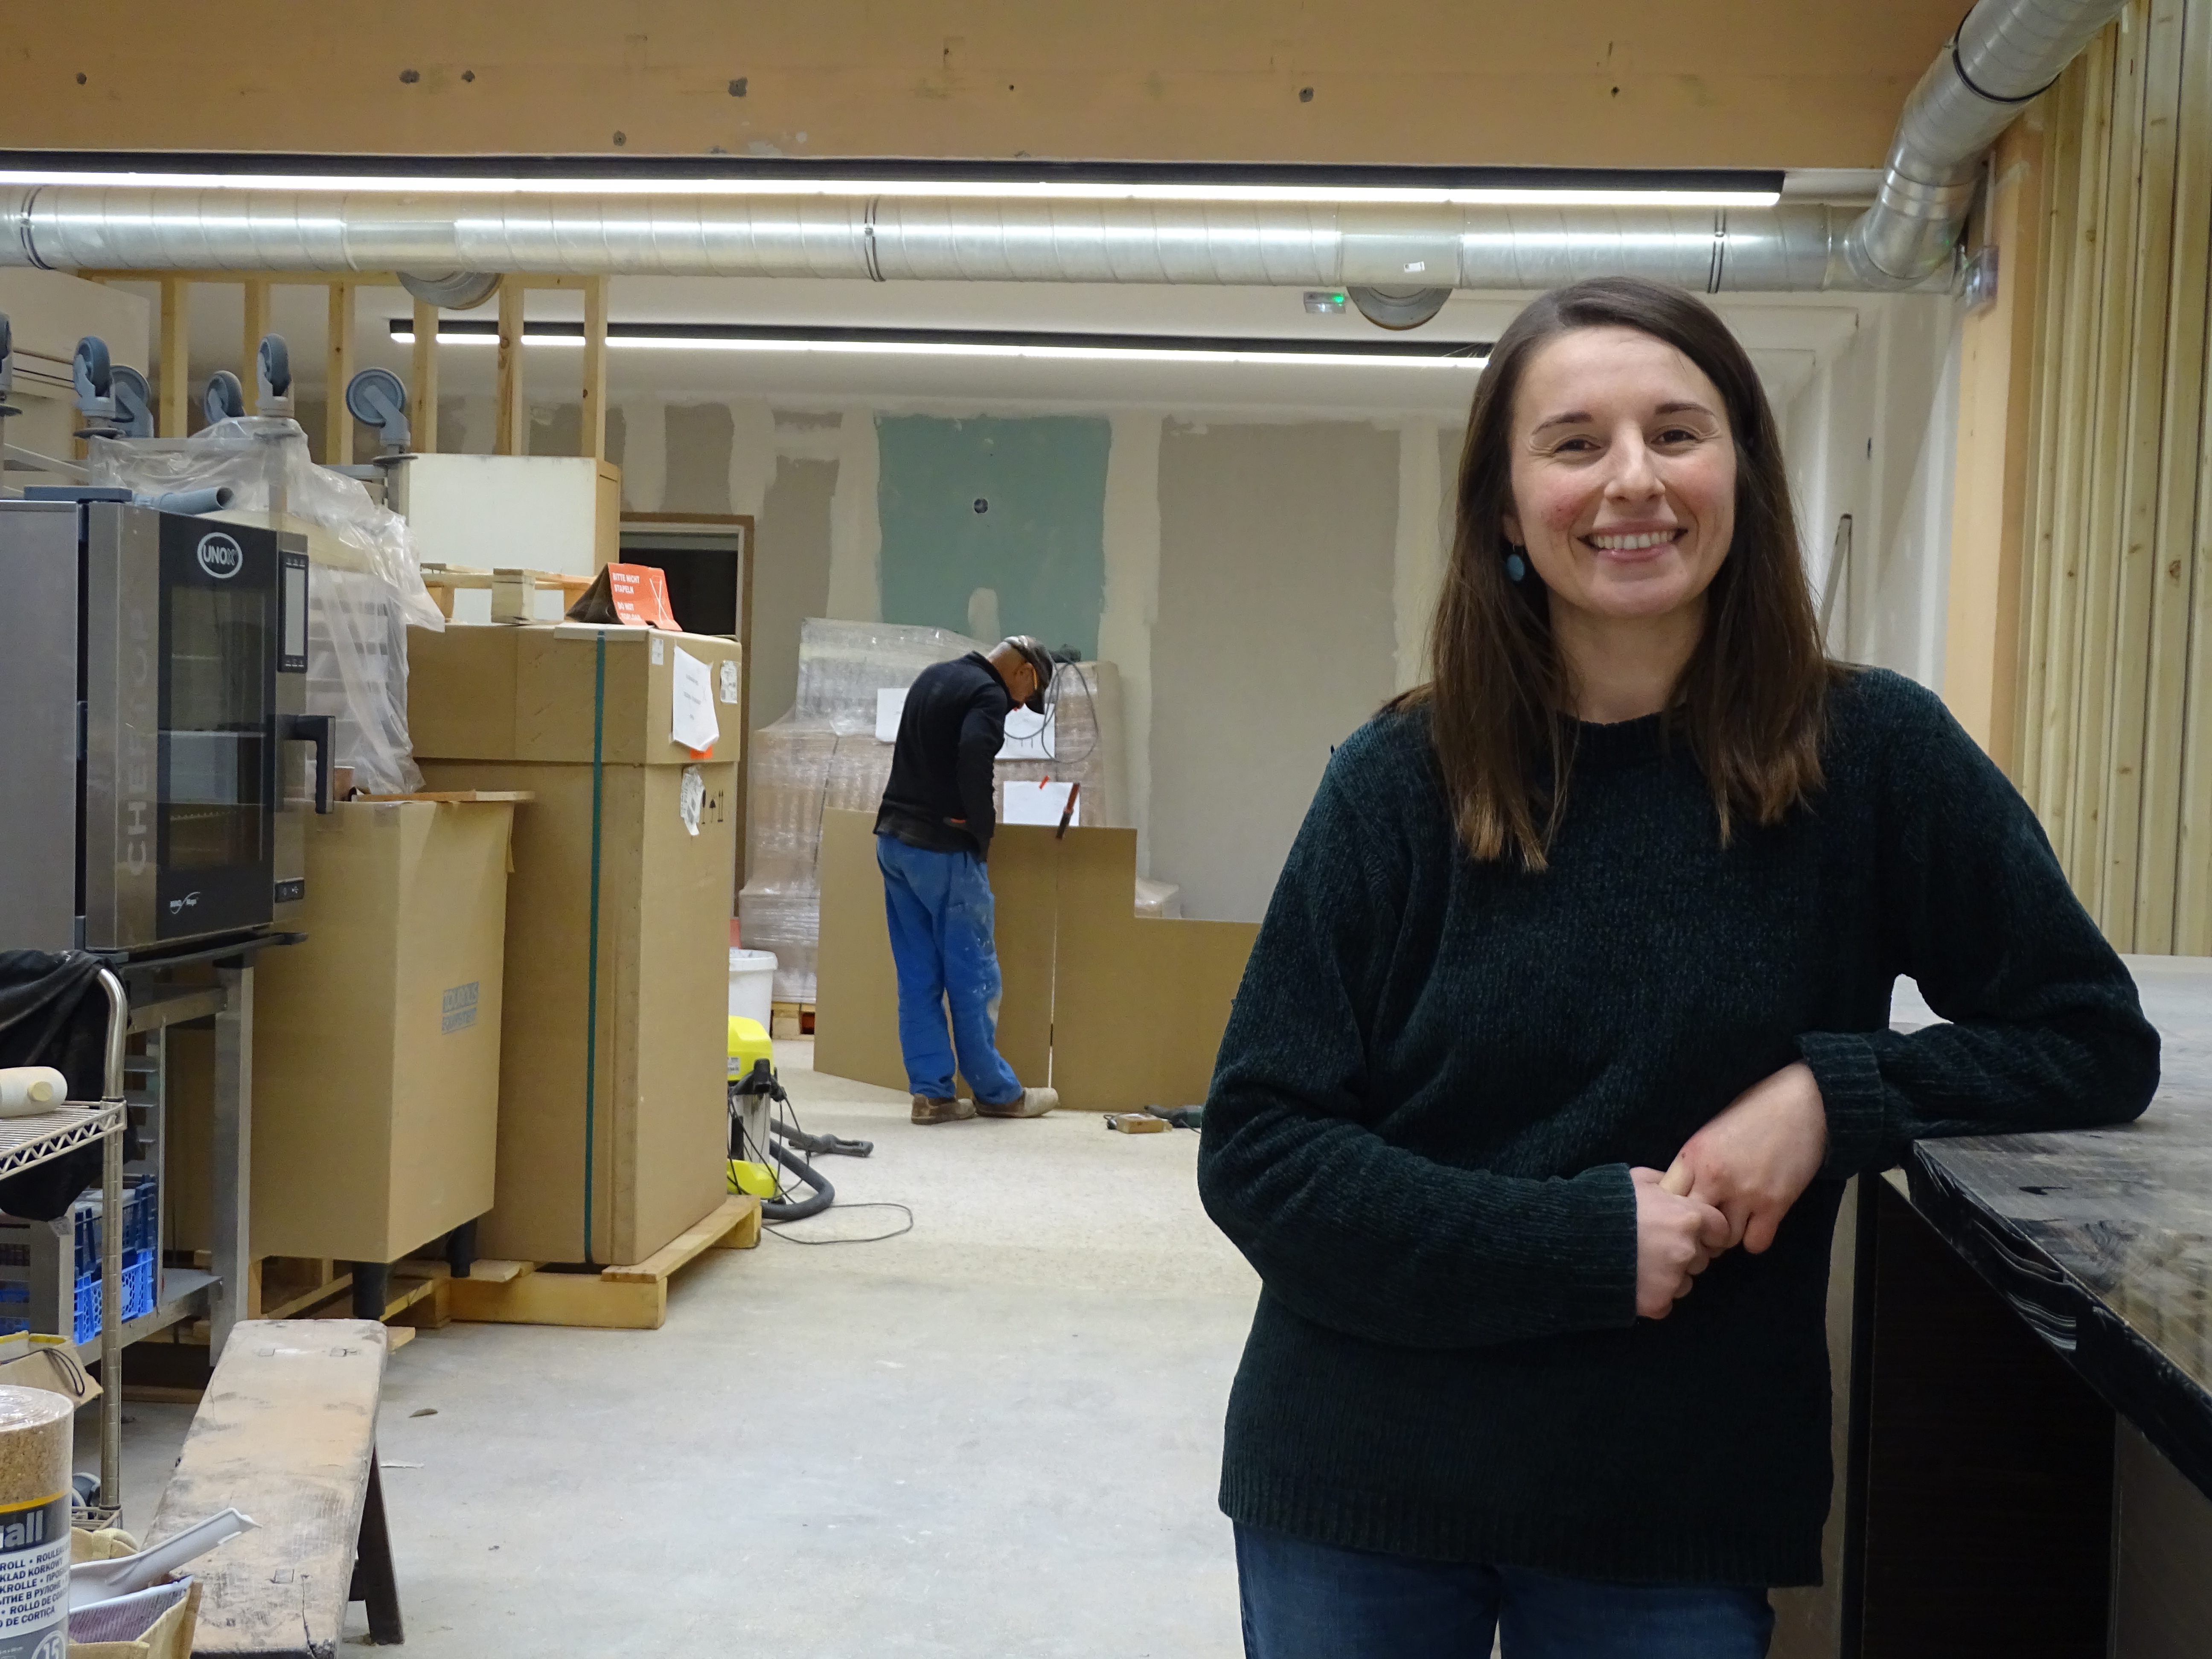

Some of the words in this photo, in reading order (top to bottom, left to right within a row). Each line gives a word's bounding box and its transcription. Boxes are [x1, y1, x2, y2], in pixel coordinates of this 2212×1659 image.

[204, 544, 236, 566] UNOX
[612, 572, 626, 582] BITTE
[626, 574, 640, 584] NICHT
[614, 584, 634, 594] STAPELN
[0, 1559, 26, 1571] ROLL
[0, 1578, 37, 1594] KROLLE
[10, 1600, 40, 1615] ROLLO
[42, 1595, 51, 1607] DE
[6, 1616, 19, 1627] DE
